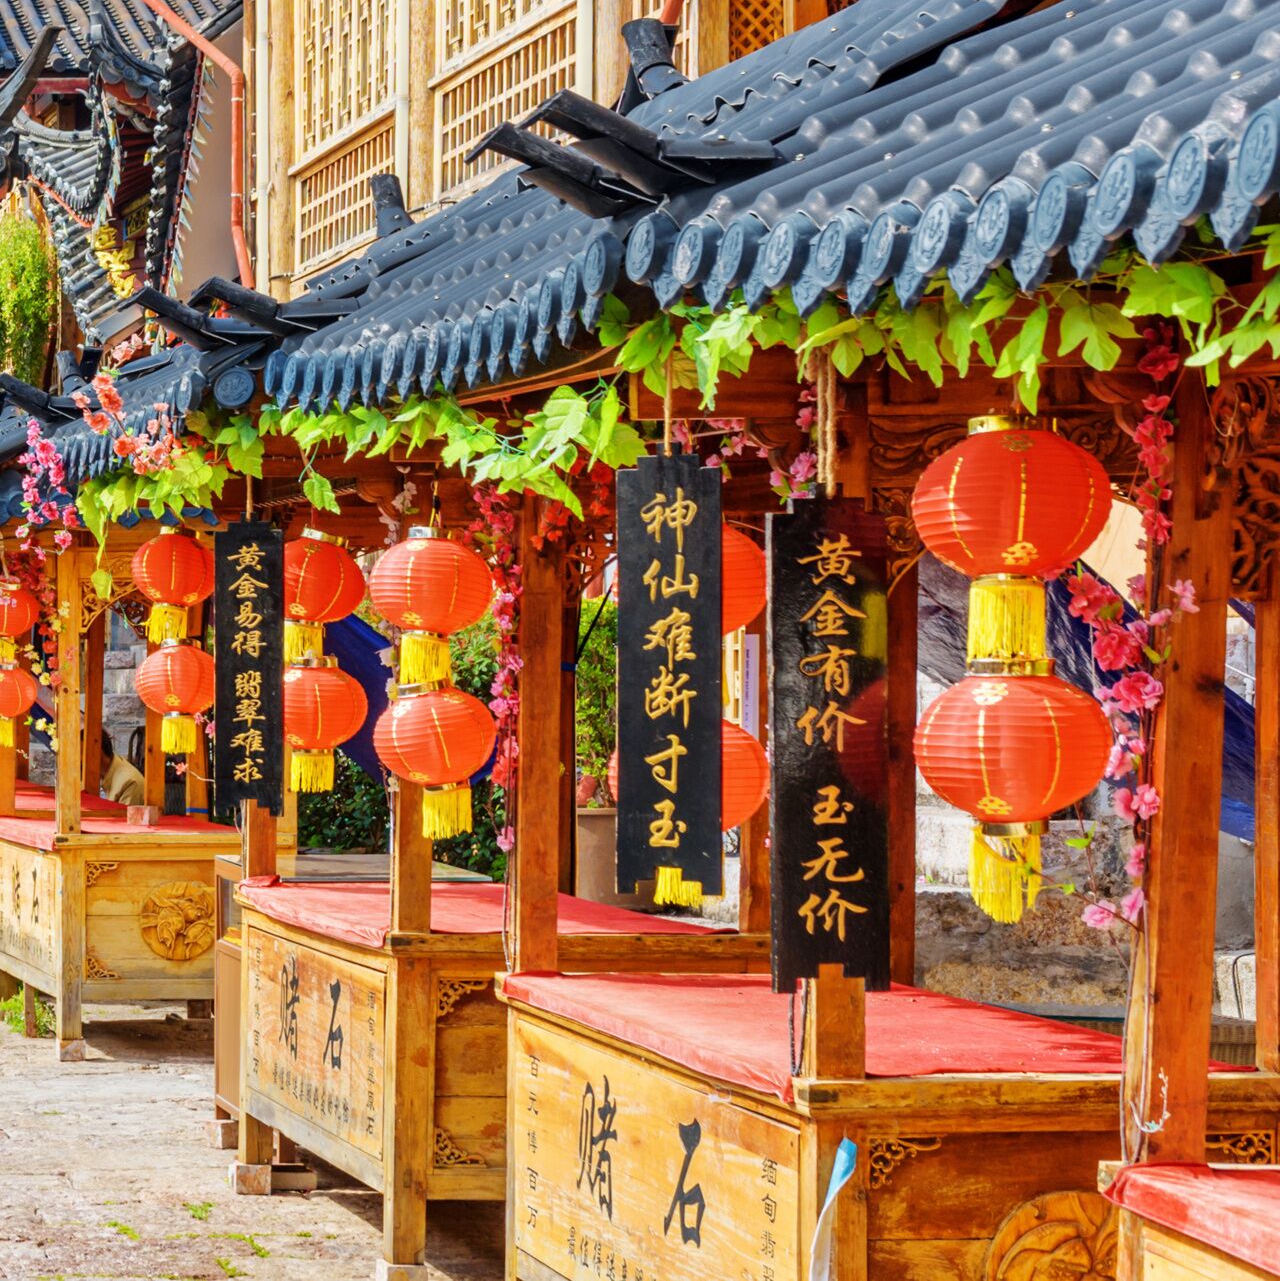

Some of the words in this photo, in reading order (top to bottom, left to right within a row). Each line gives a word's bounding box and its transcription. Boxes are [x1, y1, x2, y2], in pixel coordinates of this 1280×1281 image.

[640, 486, 700, 849] 神仙难断寸玉
[278, 954, 344, 1070] 赌石
[576, 1074, 706, 1249] 赌石
